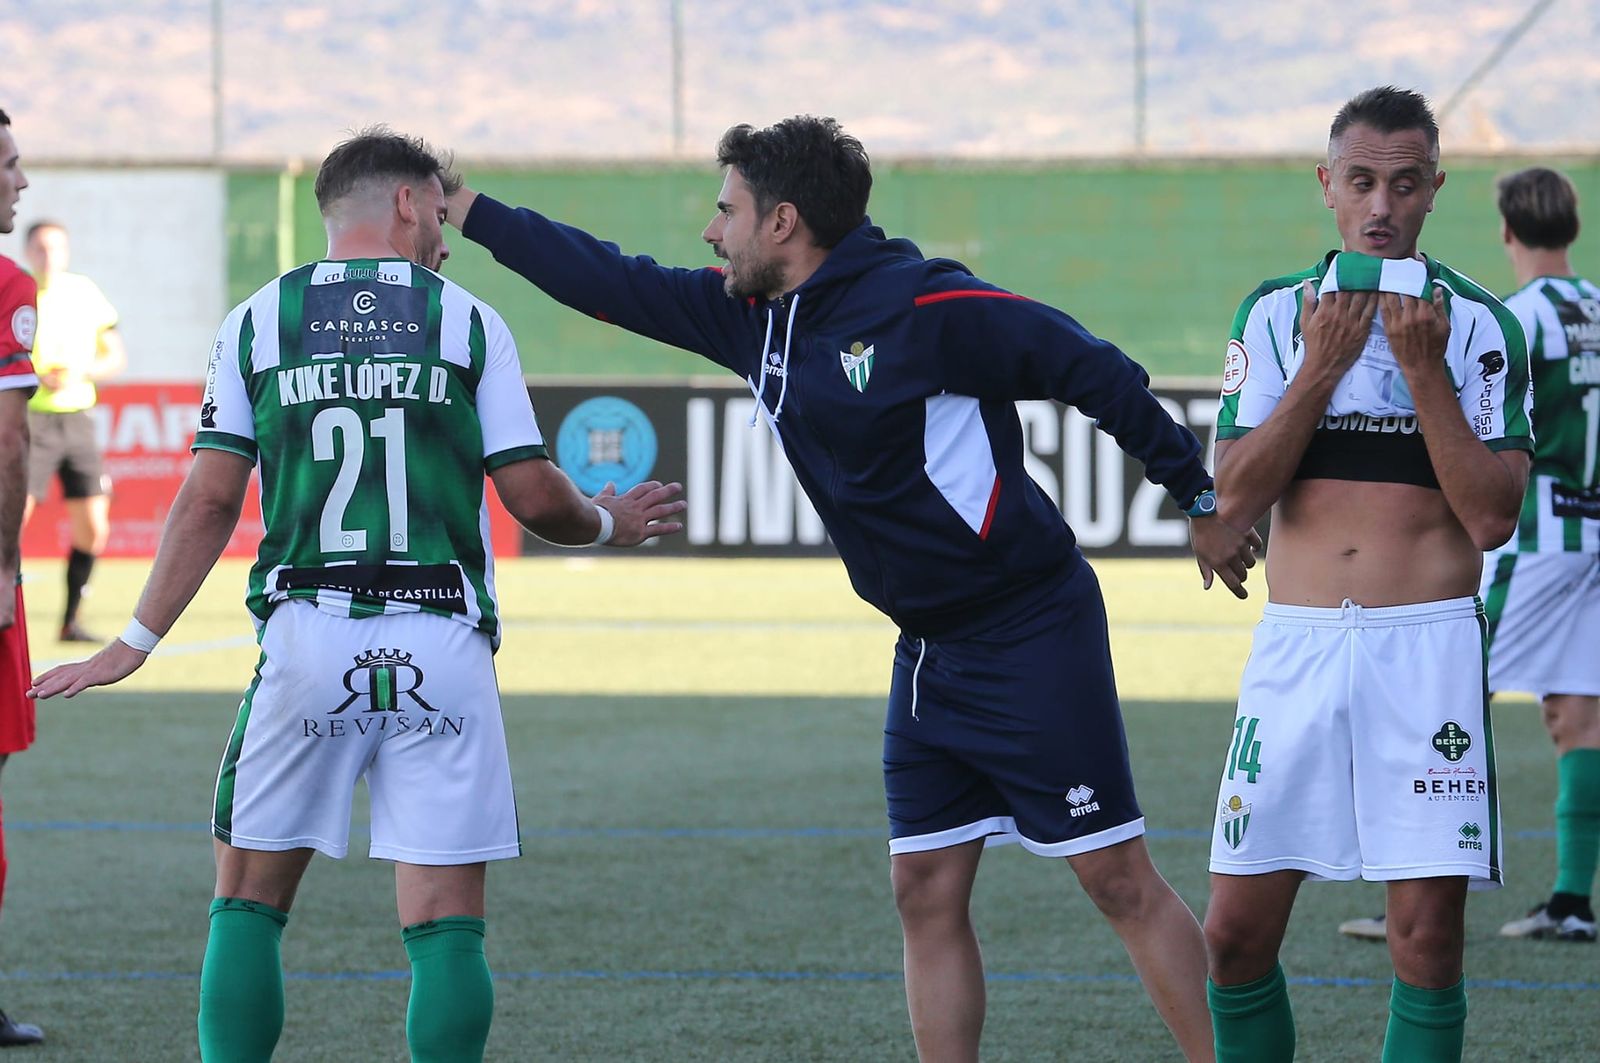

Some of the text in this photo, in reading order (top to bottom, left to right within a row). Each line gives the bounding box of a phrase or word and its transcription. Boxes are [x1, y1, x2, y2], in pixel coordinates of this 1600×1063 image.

[309, 319, 420, 334] CARRASCO
[277, 358, 452, 407] KIKE LÓPEZ D.
[310, 406, 409, 553] 21
[393, 588, 463, 600] CASTILLA
[302, 716, 466, 738] REVISAN
[1227, 715, 1262, 784] 14
[1435, 738, 1470, 746] BEHER
[1413, 779, 1487, 795] BEHER
[1069, 801, 1101, 818] errea
[1458, 839, 1483, 851] errea
